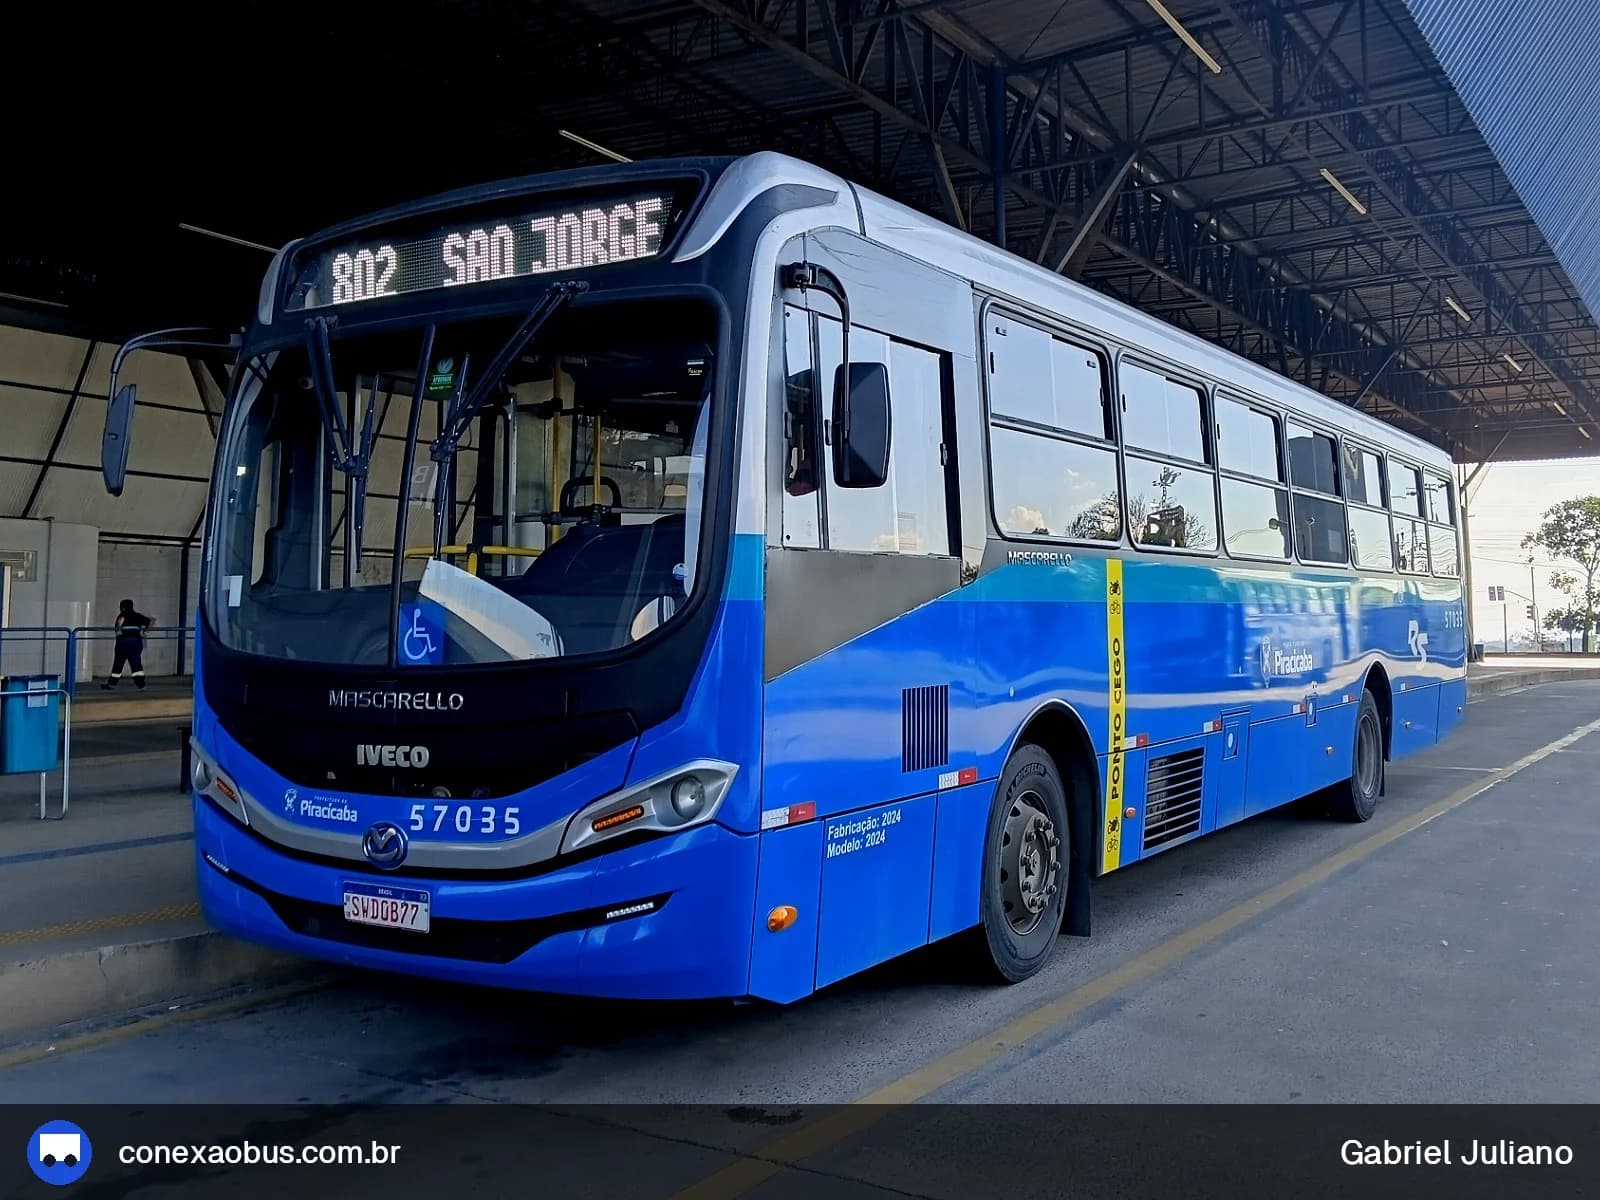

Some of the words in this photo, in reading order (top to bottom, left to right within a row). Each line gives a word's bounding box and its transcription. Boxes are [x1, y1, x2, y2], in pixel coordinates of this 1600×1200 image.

[332, 244, 398, 305] 802
[531, 197, 663, 274] JORGE
[1006, 550, 1073, 567] MASCARELLO
[1112, 637, 1122, 705] CEGO
[1274, 648, 1313, 676] Piracicaba
[328, 689, 465, 711] MASCARELLO
[356, 743, 430, 769] IVECO
[1111, 712, 1122, 800] PONTO
[300, 799, 358, 823] Piracicaba
[410, 804, 520, 835] 57035
[827, 815, 880, 841] Fabricação:
[881, 808, 902, 828] 2024
[826, 836, 864, 859] Modelo:
[865, 828, 886, 849] 2024
